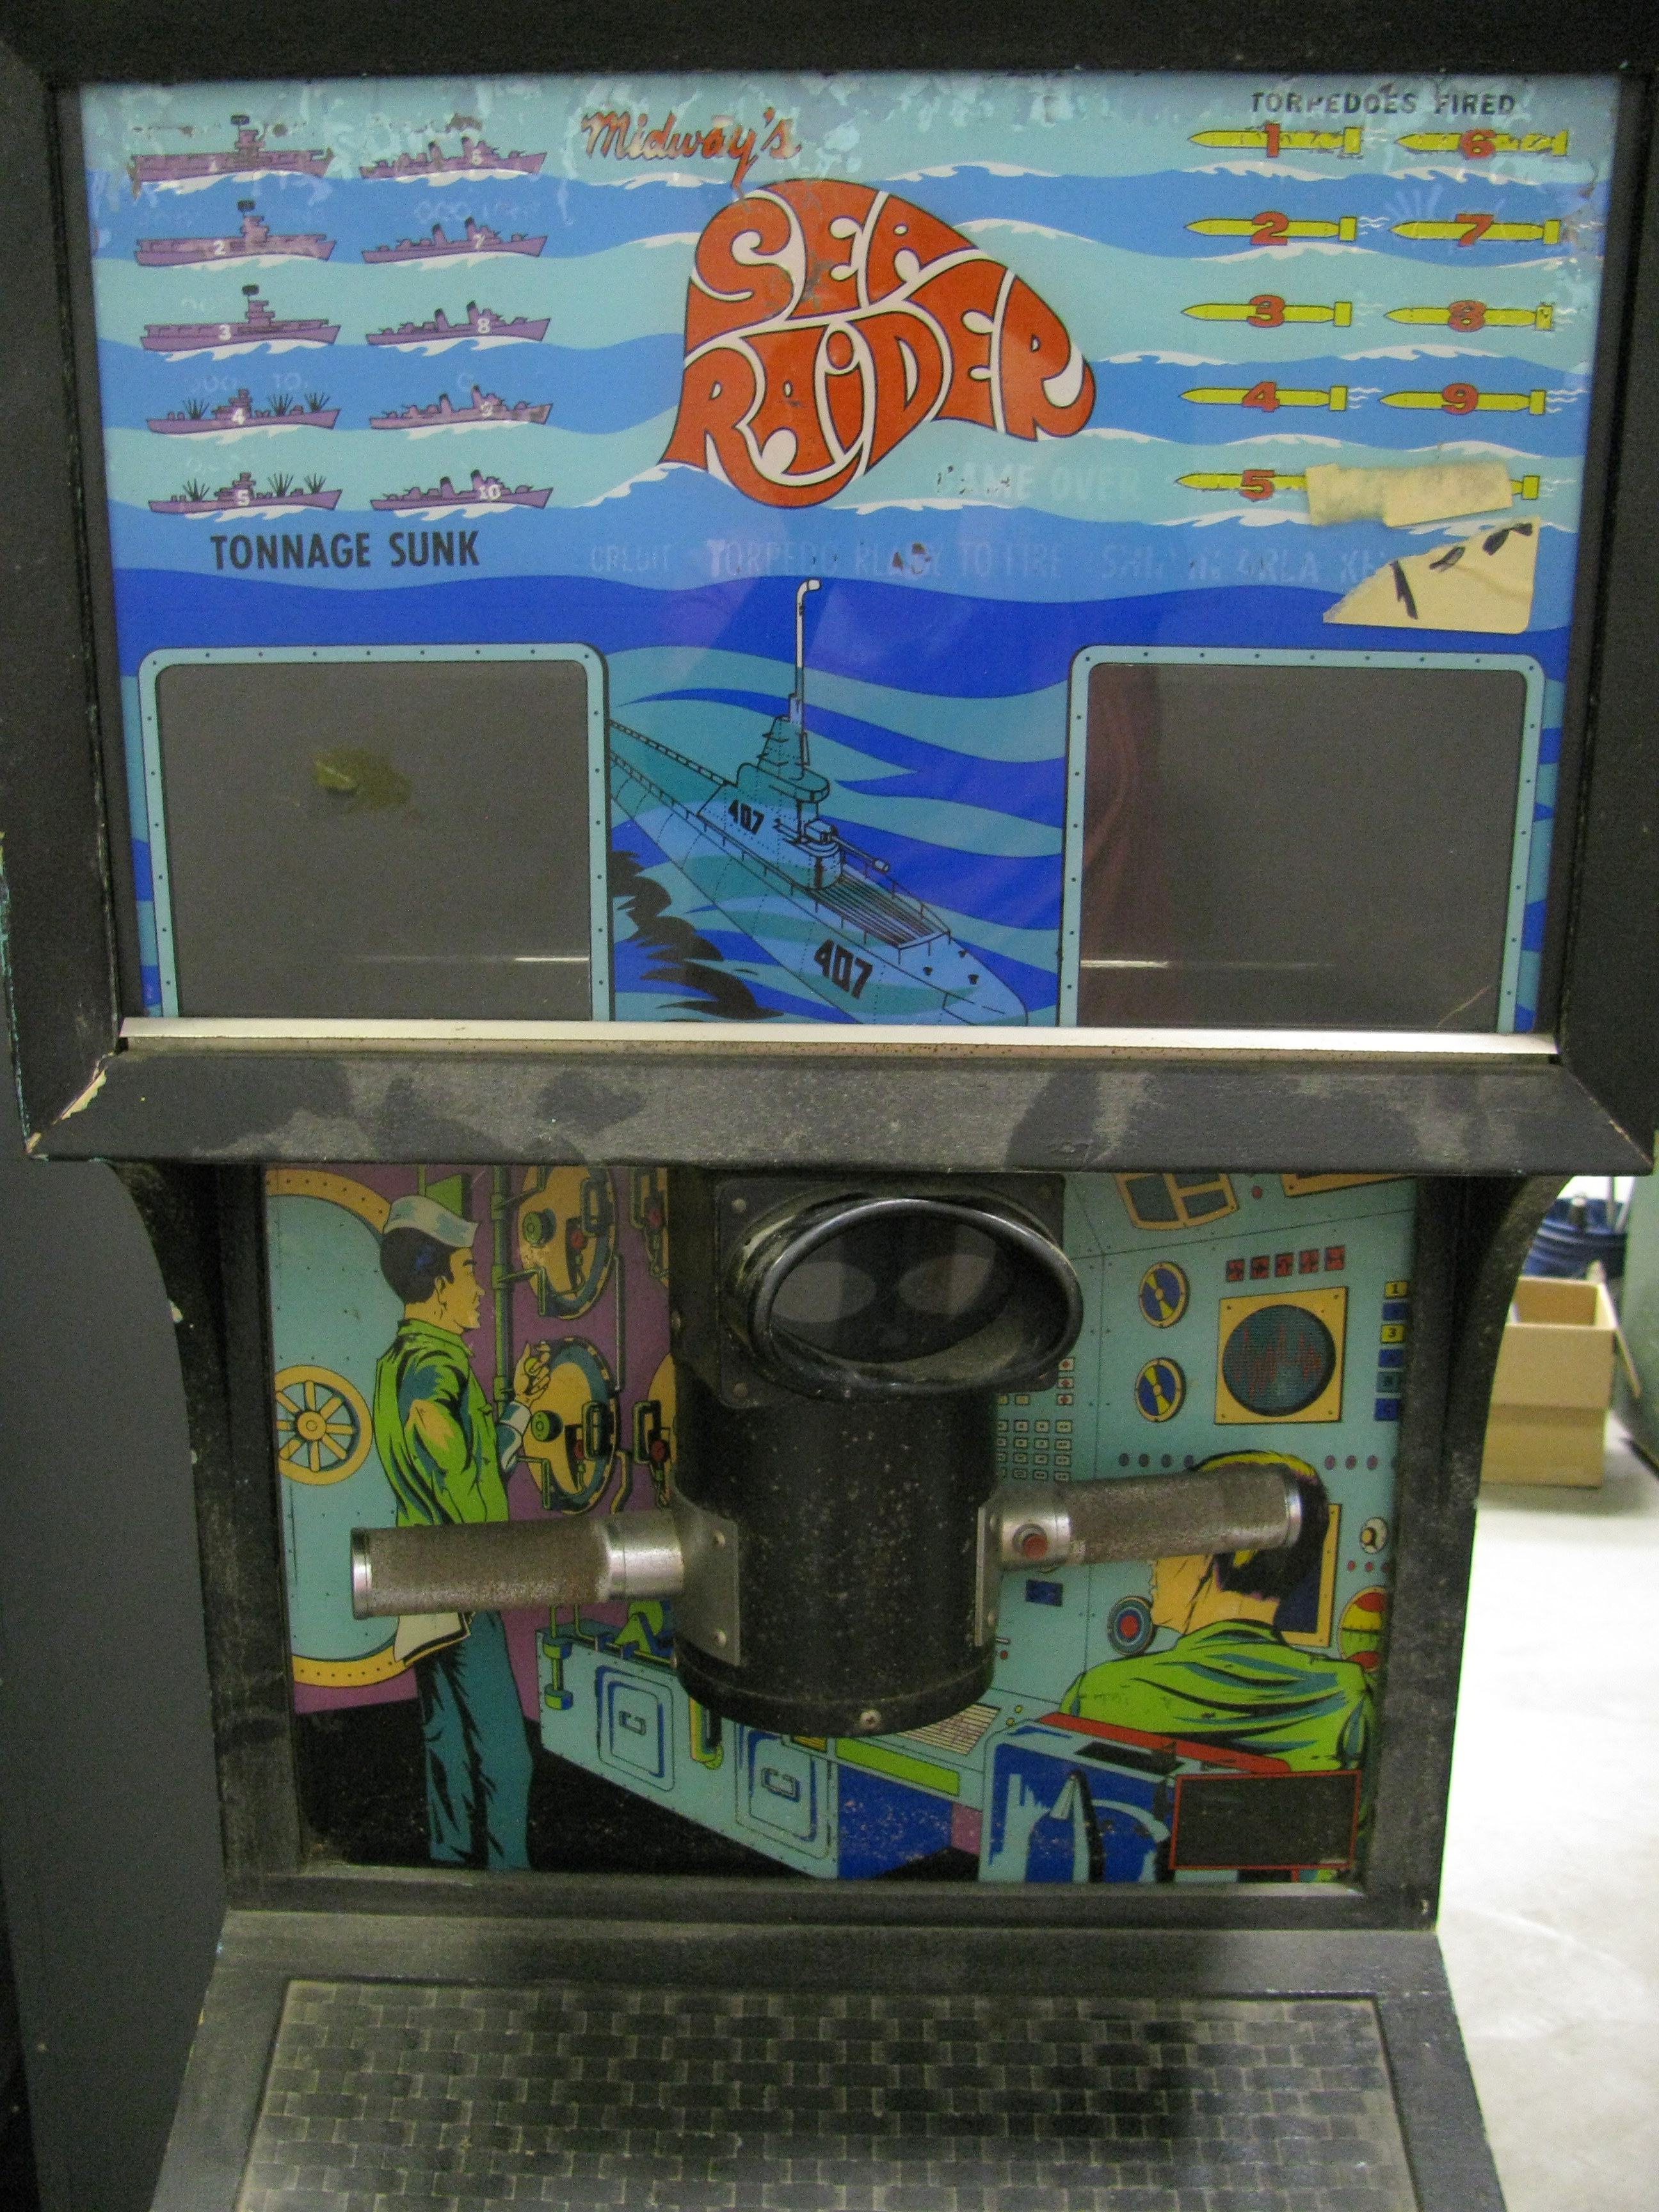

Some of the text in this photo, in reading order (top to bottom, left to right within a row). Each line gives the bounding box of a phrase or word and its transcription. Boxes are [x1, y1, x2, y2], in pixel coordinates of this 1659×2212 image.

[1251, 91, 1517, 116] TORPEDOES FIRED
[582, 106, 802, 188] Midway's
[1264, 123, 1281, 158] 1
[1460, 127, 1496, 159] 6
[473, 234, 486, 250] 7
[1251, 211, 1290, 246] 2
[1455, 213, 1495, 246] 7
[212, 239, 226, 256] 2
[694, 179, 982, 316] SEA
[477, 317, 491, 333] 8
[1247, 294, 1286, 328] 3
[1446, 300, 1487, 332] 8
[218, 323, 232, 341] 3
[659, 257, 1096, 509] RAIDER
[1242, 381, 1281, 413] 4
[1440, 382, 1479, 415] 9
[231, 408, 246, 425] 4
[234, 489, 250, 506] 5
[477, 484, 501, 501] 10
[1240, 469, 1276, 502] 5
[211, 530, 481, 569] TONNAGE SUNK
[728, 798, 765, 835] 407
[813, 938, 874, 999] 407
